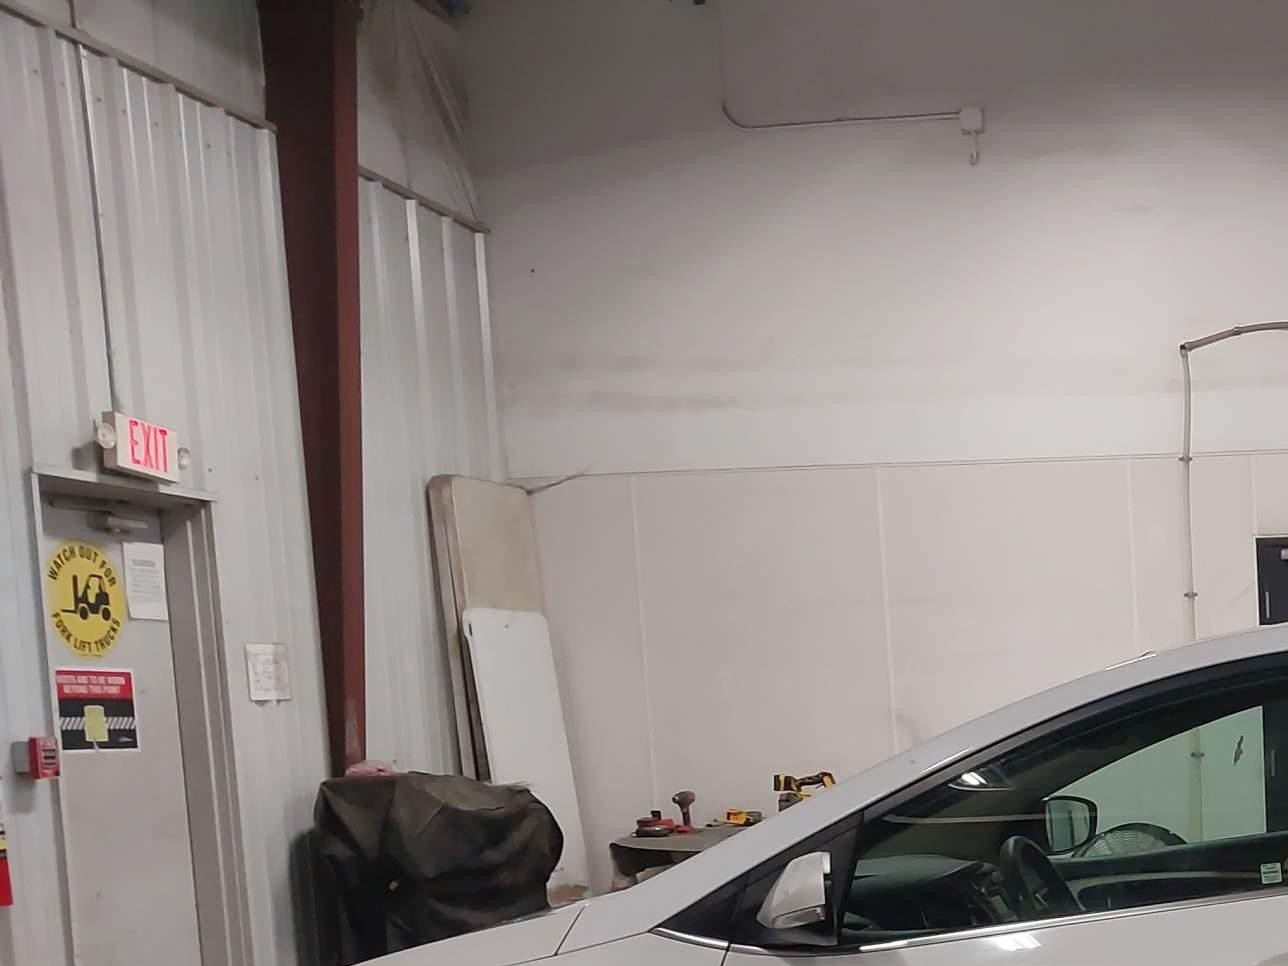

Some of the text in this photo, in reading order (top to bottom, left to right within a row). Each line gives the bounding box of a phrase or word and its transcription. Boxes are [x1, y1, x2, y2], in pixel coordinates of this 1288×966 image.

[128, 419, 167, 473] EXIT
[48, 545, 77, 581] WATCH
[79, 545, 99, 563] OUT
[99, 559, 117, 588] FOR
[52, 611, 121, 653] FORK LIFT TRUCKS
